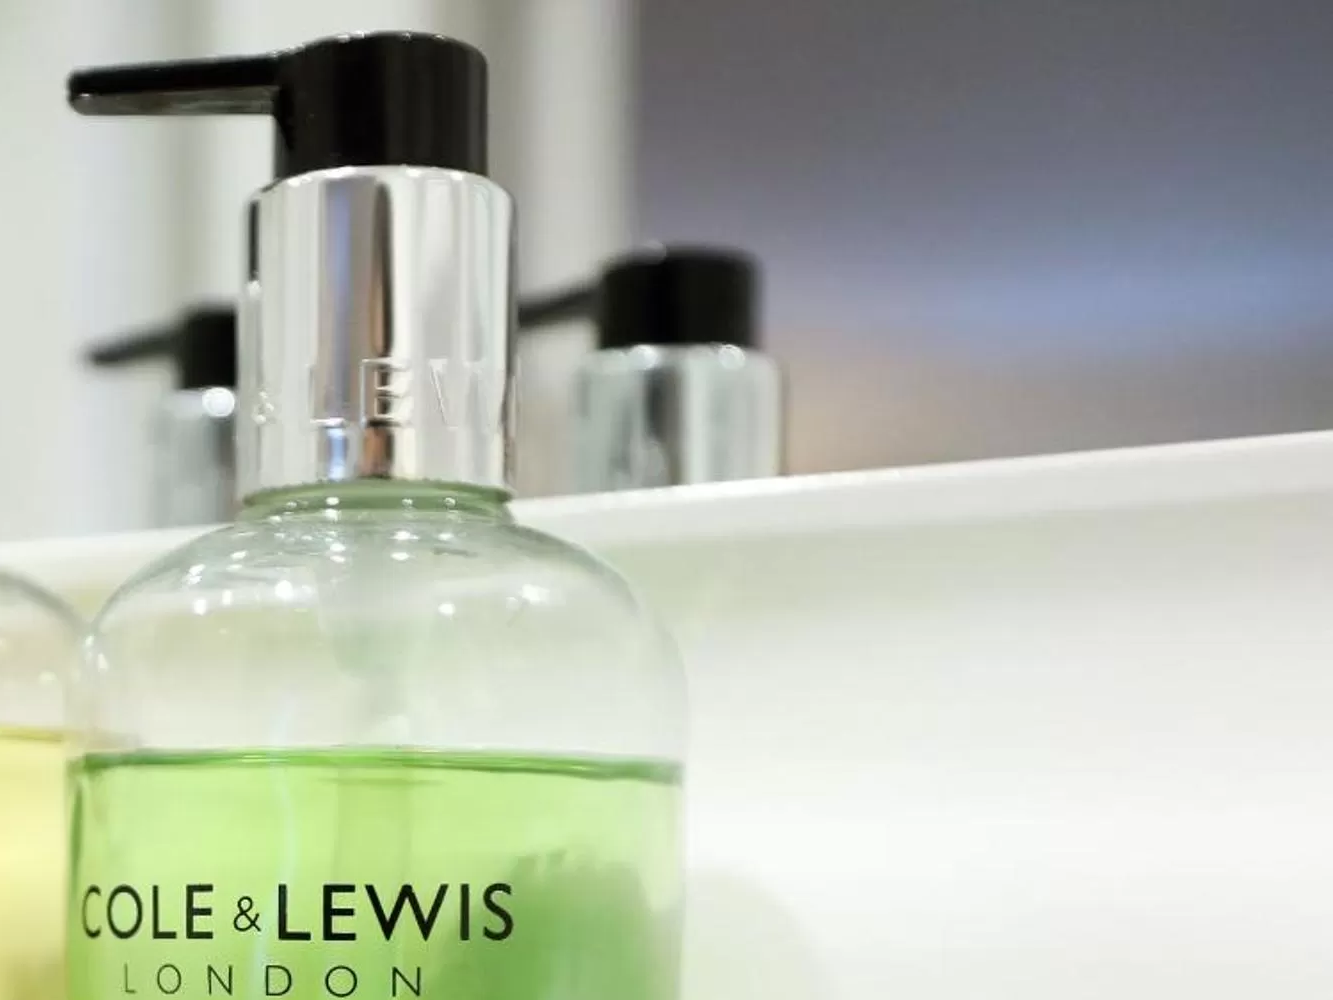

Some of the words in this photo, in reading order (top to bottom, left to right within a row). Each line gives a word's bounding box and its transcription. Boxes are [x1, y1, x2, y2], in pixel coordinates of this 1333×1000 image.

[80, 883, 215, 940] COLE
[232, 894, 263, 933] &
[276, 882, 515, 942] LEWIS
[122, 962, 423, 998] LONDON
